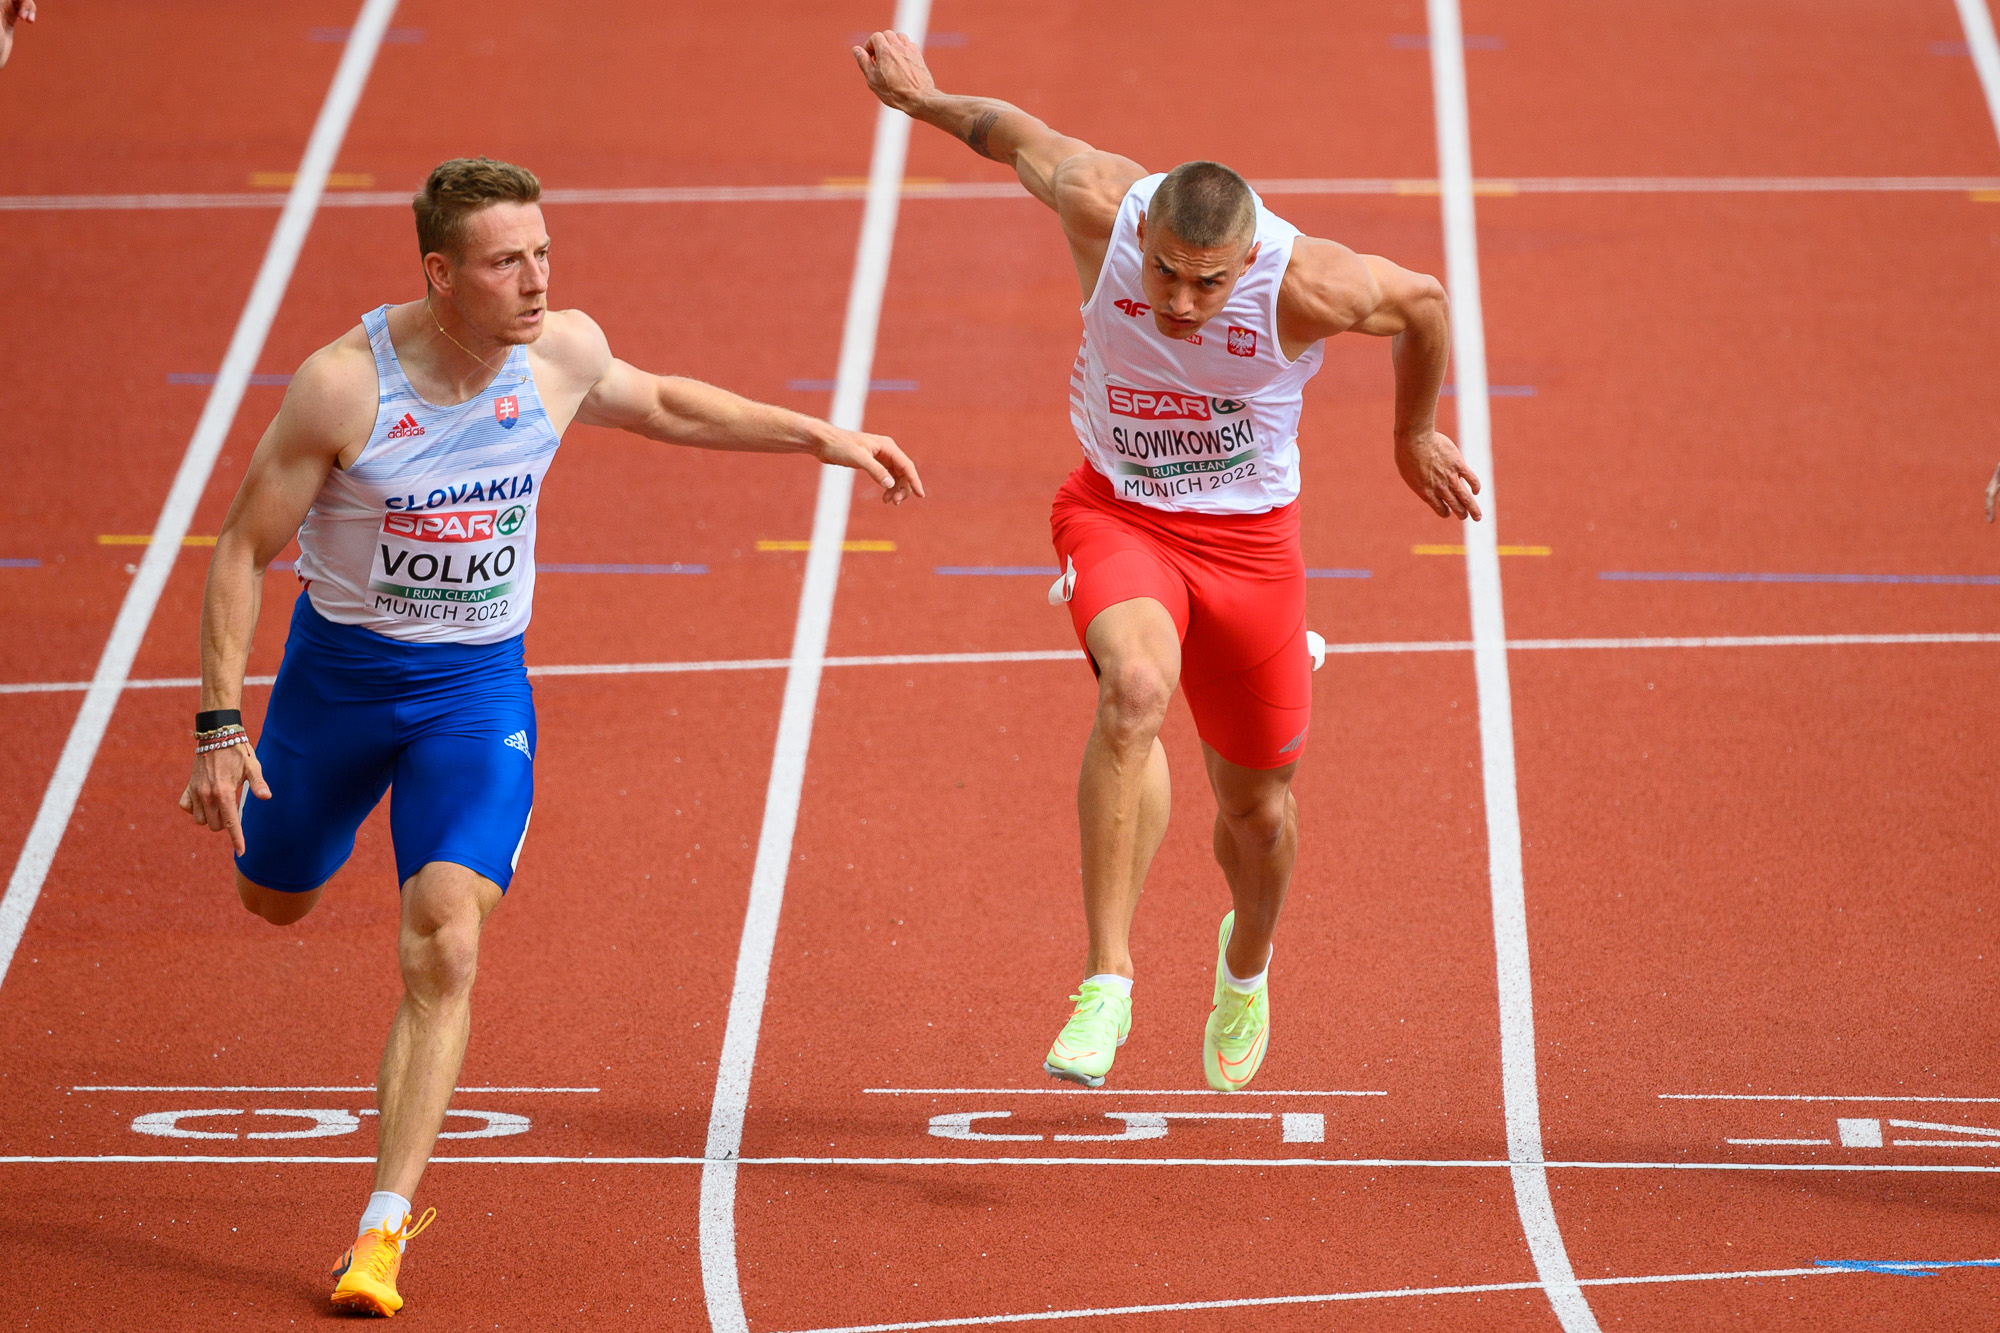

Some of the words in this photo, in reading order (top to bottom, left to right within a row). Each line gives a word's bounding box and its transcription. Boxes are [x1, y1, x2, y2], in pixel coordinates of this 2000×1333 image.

[1113, 298, 1152, 318] 4F
[1110, 389, 1208, 416] SPAR
[387, 426, 426, 439] adidas
[1112, 418, 1255, 460] SLOWIKOWSKI
[1124, 477, 1203, 498] MUNICH
[1209, 462, 1257, 490] 2022
[1152, 464, 1181, 478] RUN
[385, 473, 533, 512] SLOVAKIA
[388, 515, 493, 540] SPAR
[381, 544, 516, 584] VOLKO
[412, 588, 442, 600] RUN
[374, 595, 459, 621] MUNICH
[464, 599, 509, 622] 2022
[927, 1110, 1326, 1142] 5
